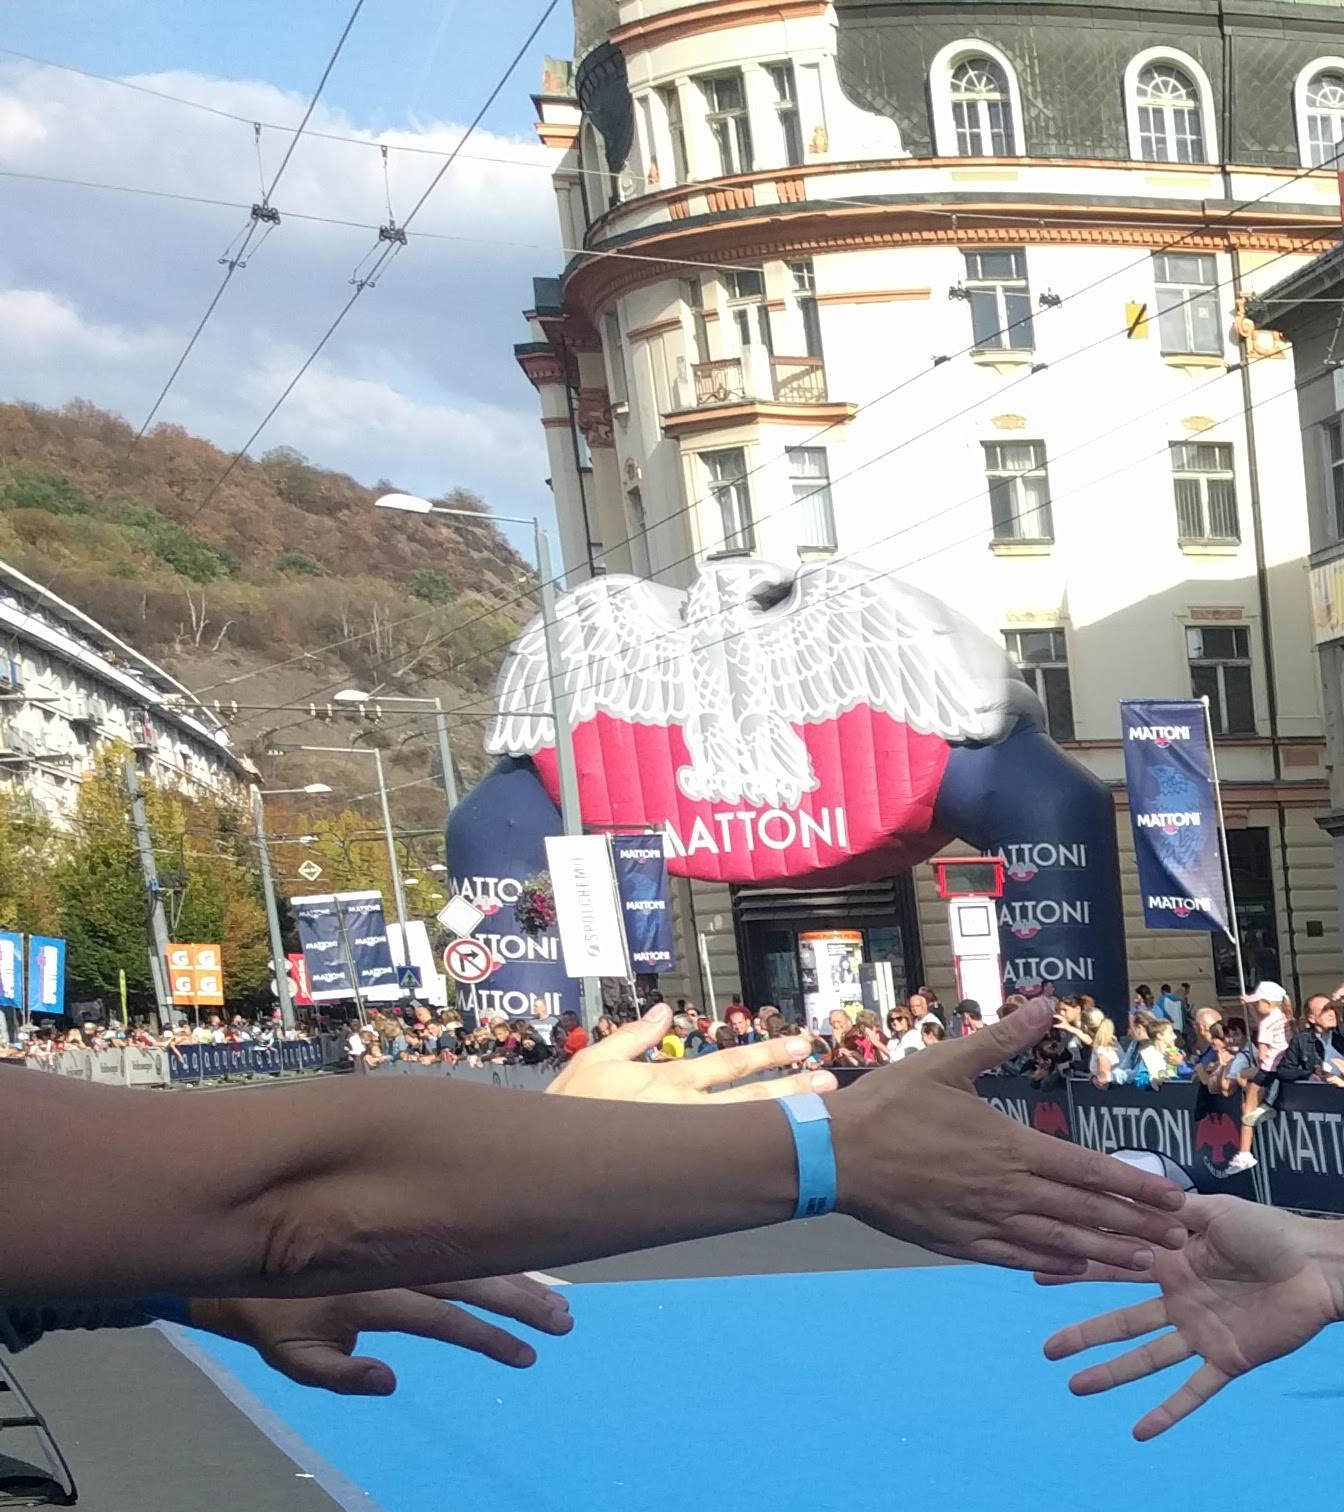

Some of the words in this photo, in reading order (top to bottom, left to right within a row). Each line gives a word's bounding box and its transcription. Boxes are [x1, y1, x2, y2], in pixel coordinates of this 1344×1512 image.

[1129, 726, 1191, 741] MATTONI
[1137, 812, 1201, 827] MATTONI
[1148, 896, 1213, 912] MATTONI
[475, 934, 558, 961] TTONI
